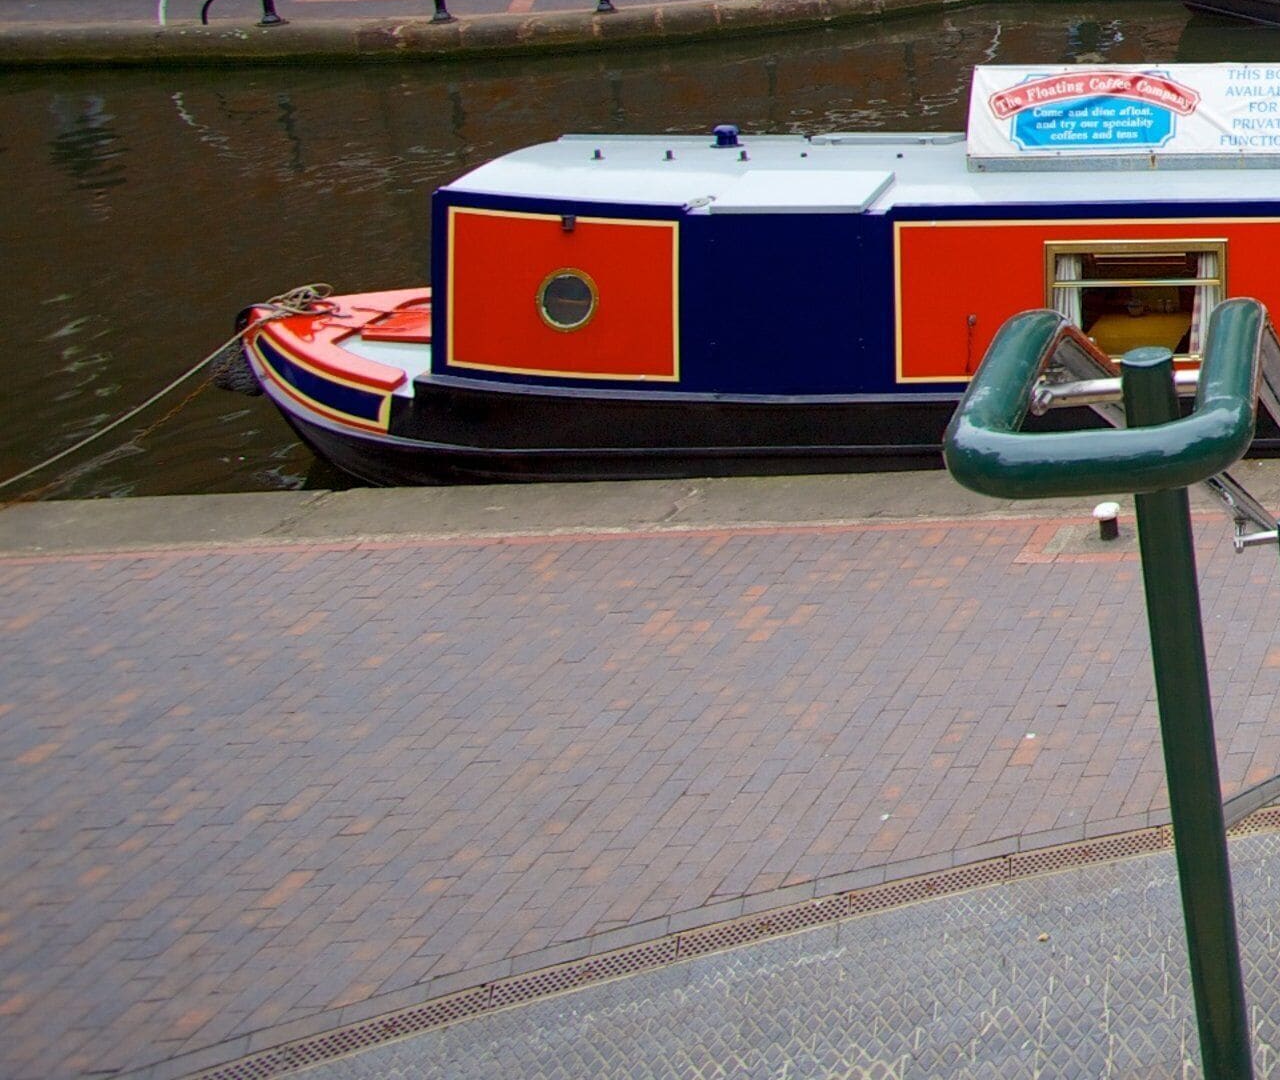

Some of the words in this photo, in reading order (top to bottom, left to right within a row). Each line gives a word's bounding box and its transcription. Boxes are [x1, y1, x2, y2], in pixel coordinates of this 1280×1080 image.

[1228, 69, 1260, 80] THIS
[996, 95, 1022, 114] The
[1025, 80, 1084, 103] Floating
[1089, 77, 1131, 91] Coffee
[1135, 80, 1193, 109] Company
[1032, 107, 1063, 118] Come
[1067, 106, 1088, 117] and
[1091, 106, 1116, 118] dine
[1248, 101, 1278, 113] FOR
[1035, 118, 1056, 129] and
[1059, 119, 1077, 132] try
[1079, 120, 1099, 129] our
[1102, 117, 1154, 132] speciality
[1050, 128, 1089, 140] coffees
[1091, 128, 1112, 140] and
[1116, 129, 1139, 139] teas
